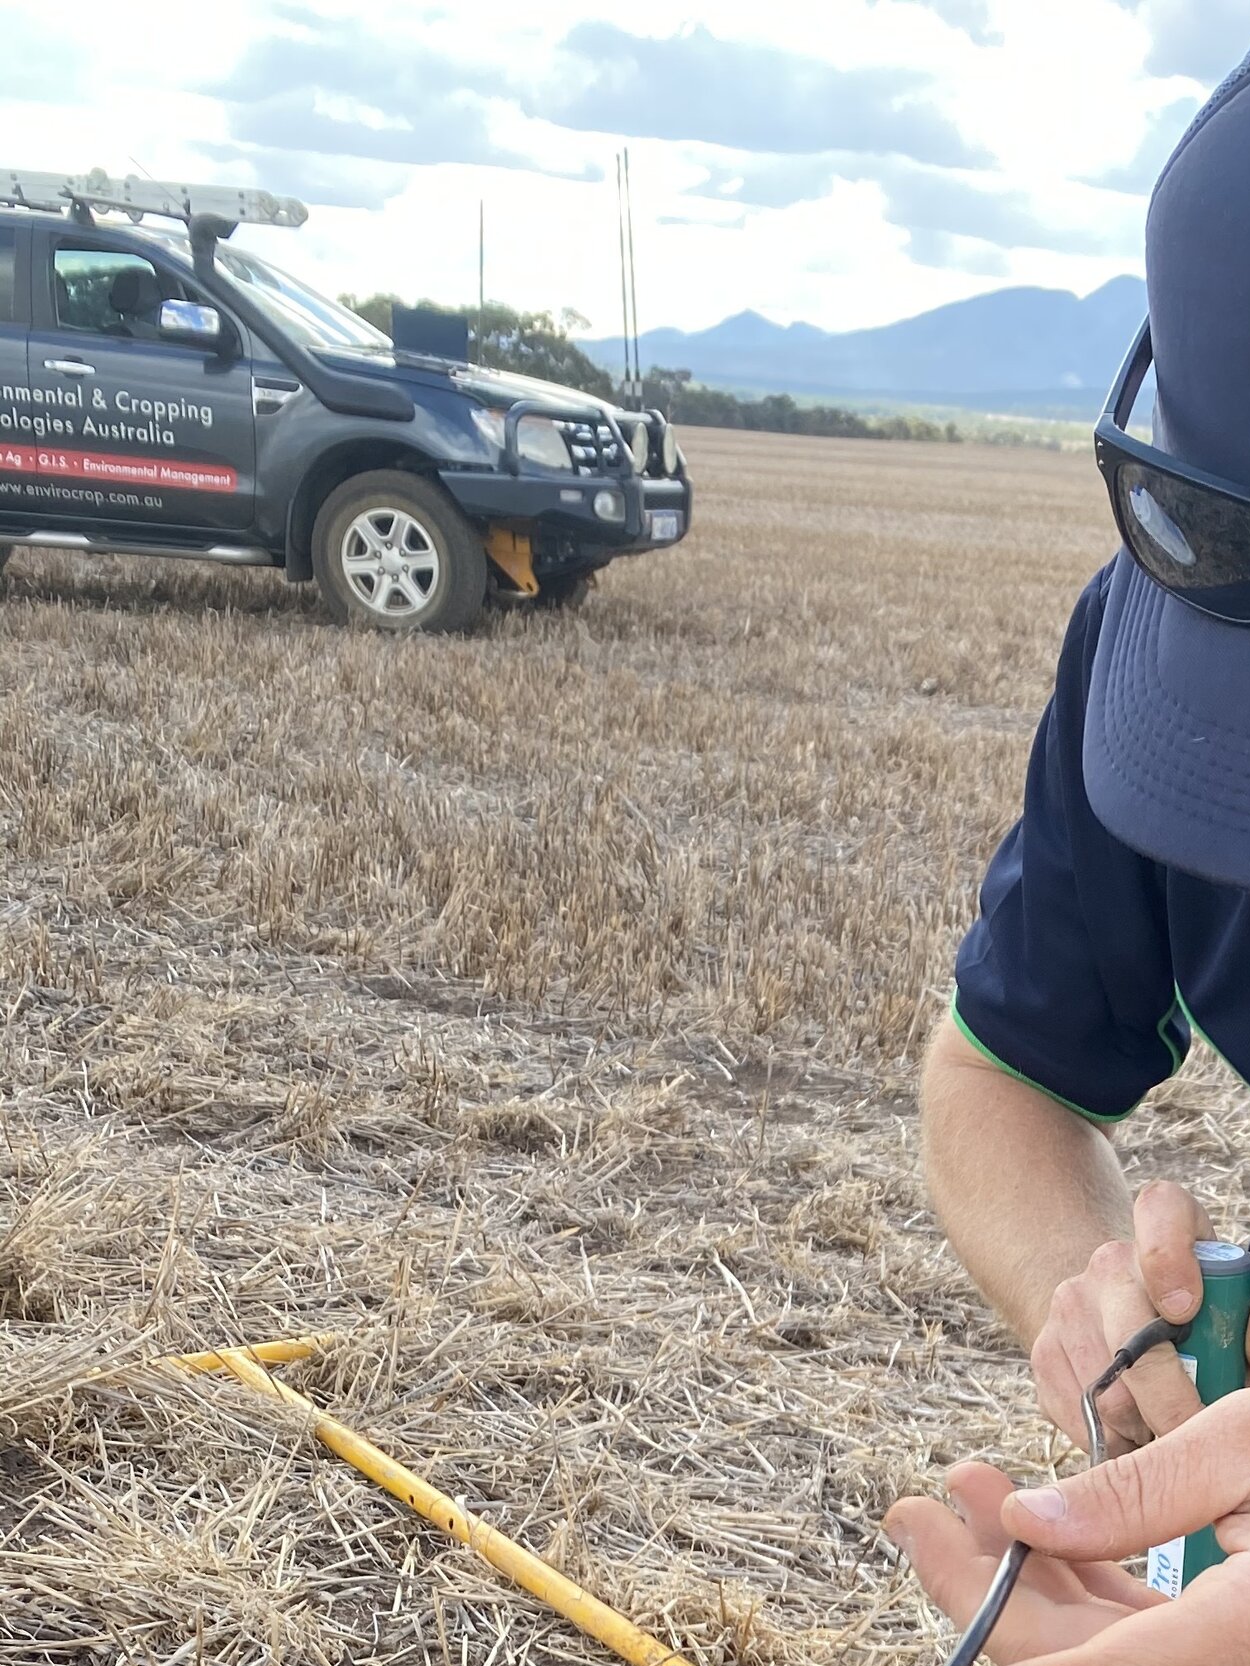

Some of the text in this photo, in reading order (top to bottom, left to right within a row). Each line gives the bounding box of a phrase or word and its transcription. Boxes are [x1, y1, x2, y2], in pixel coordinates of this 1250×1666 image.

[0, 384, 212, 427] nmental & Cropping
[0, 406, 175, 445] ologies Australia
[6, 450, 22, 468] Ag
[38, 453, 69, 468] G.I.S.
[83, 458, 157, 478] Environmental
[160, 466, 231, 486] Management
